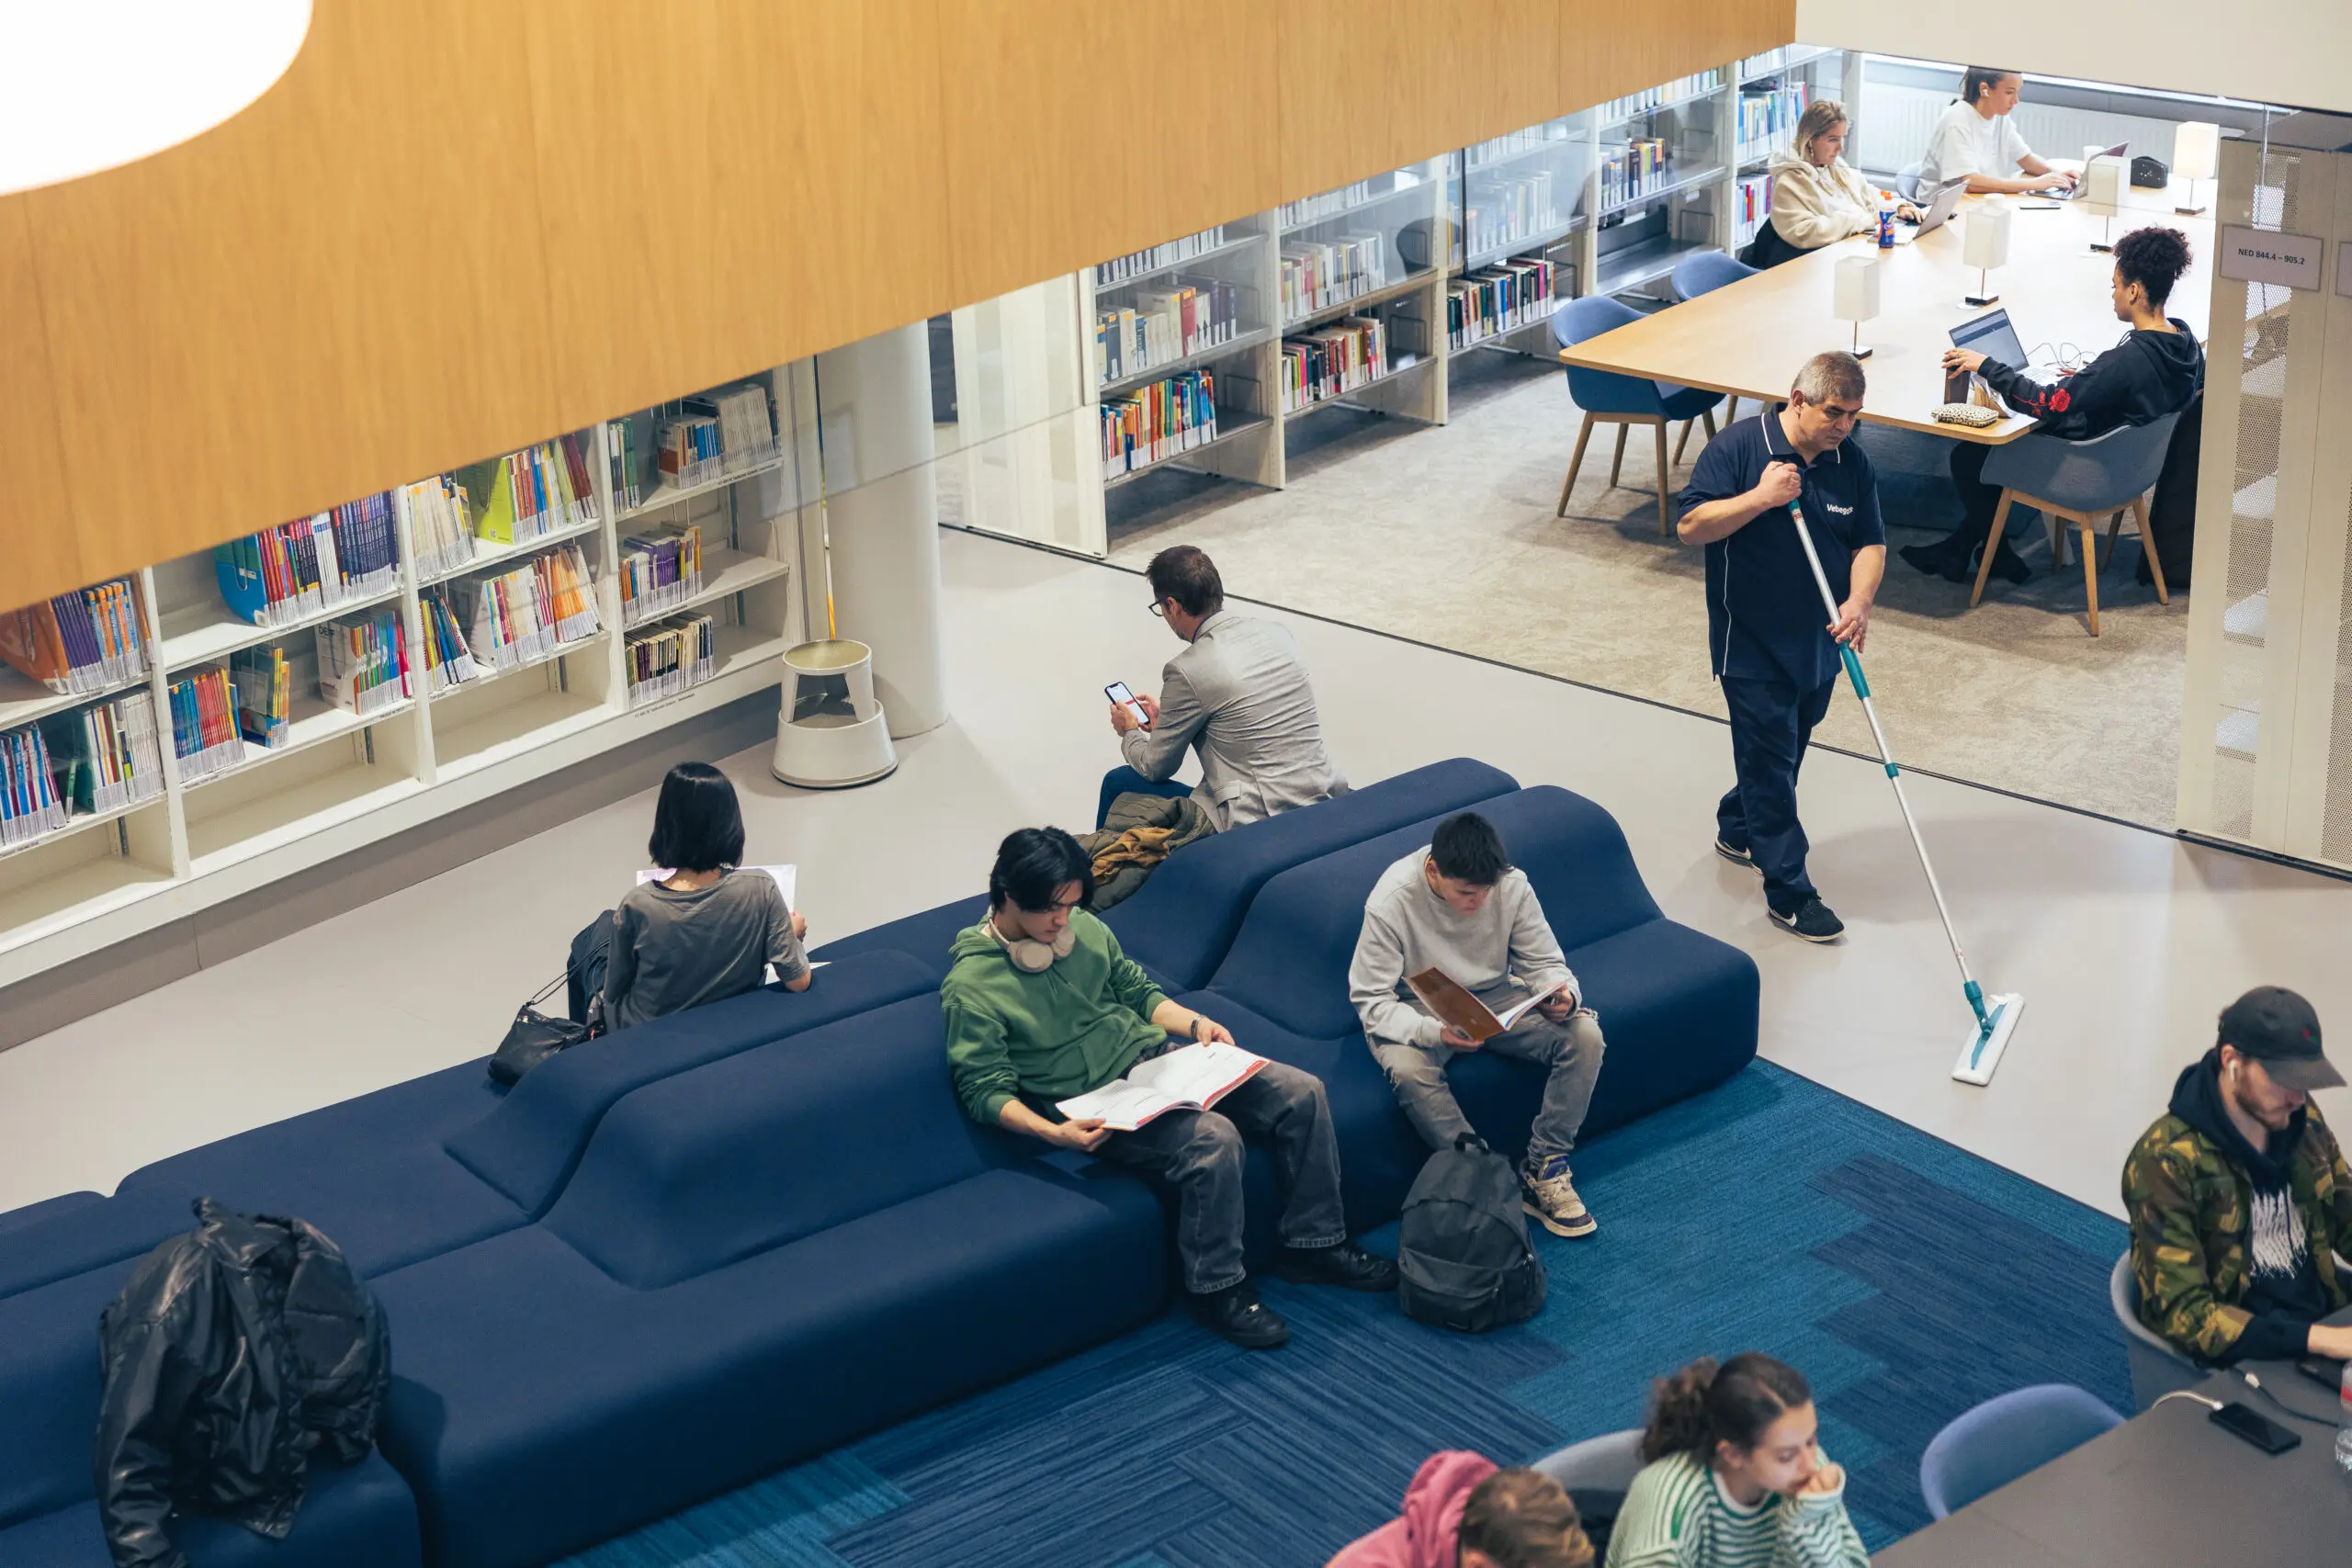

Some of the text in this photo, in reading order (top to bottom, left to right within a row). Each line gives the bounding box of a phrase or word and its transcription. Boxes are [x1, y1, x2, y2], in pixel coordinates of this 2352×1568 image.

[2238, 248, 2254, 256] NED
[2256, 251, 2276, 260] 844.4
[2284, 255, 2305, 265] 905.2
[318, 626, 335, 637] DEF
